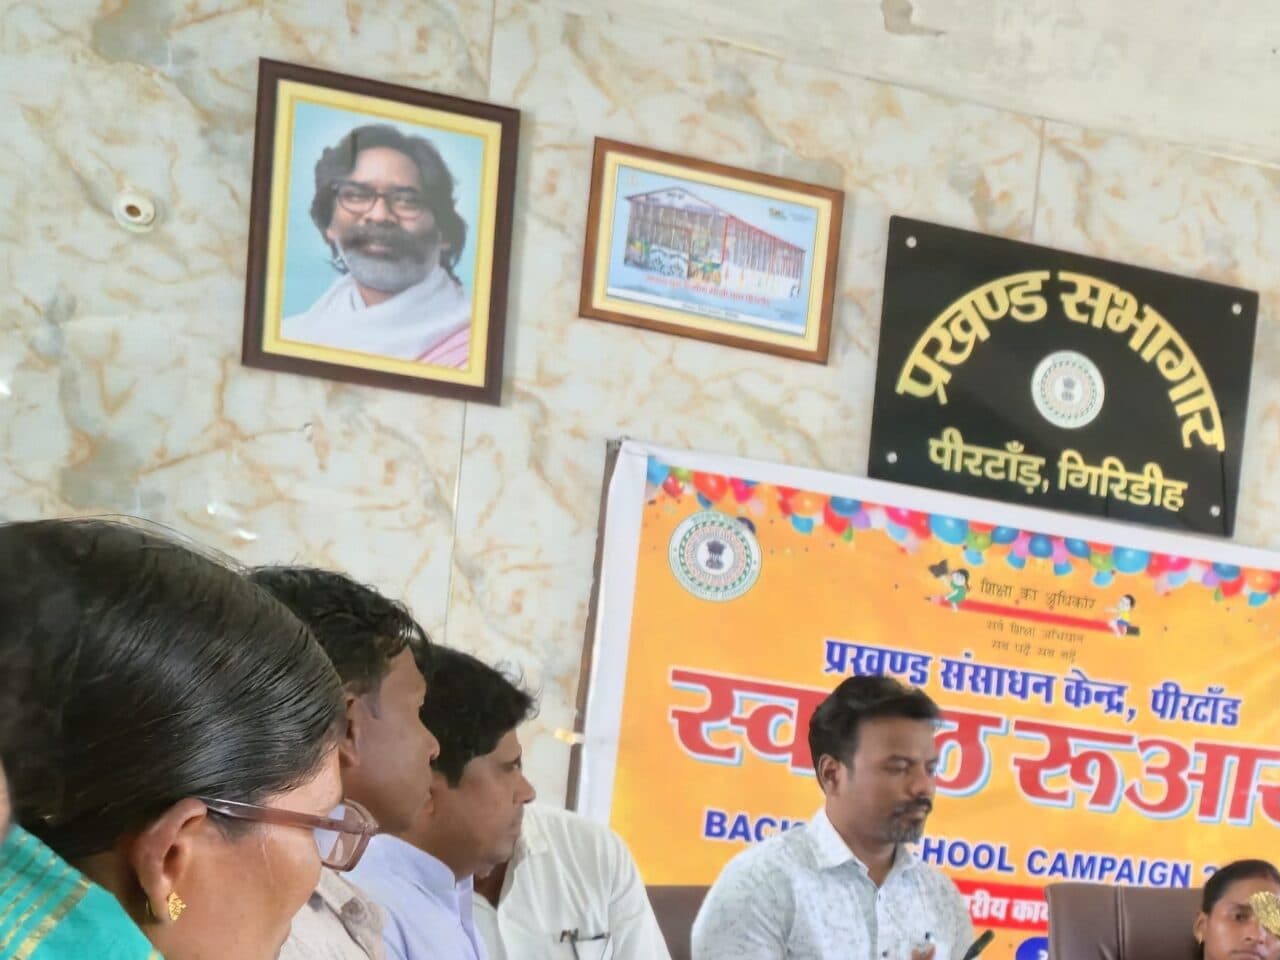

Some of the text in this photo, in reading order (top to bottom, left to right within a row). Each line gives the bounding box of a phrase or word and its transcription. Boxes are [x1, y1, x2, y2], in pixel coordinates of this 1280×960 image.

[895, 269, 1225, 453] प्रखण्ड सभागार
[1057, 448, 1189, 512] गिरिडीह
[940, 651, 1056, 705] संसाधन
[704, 809, 1191, 888] BAC HOOL CAMPAIGN
